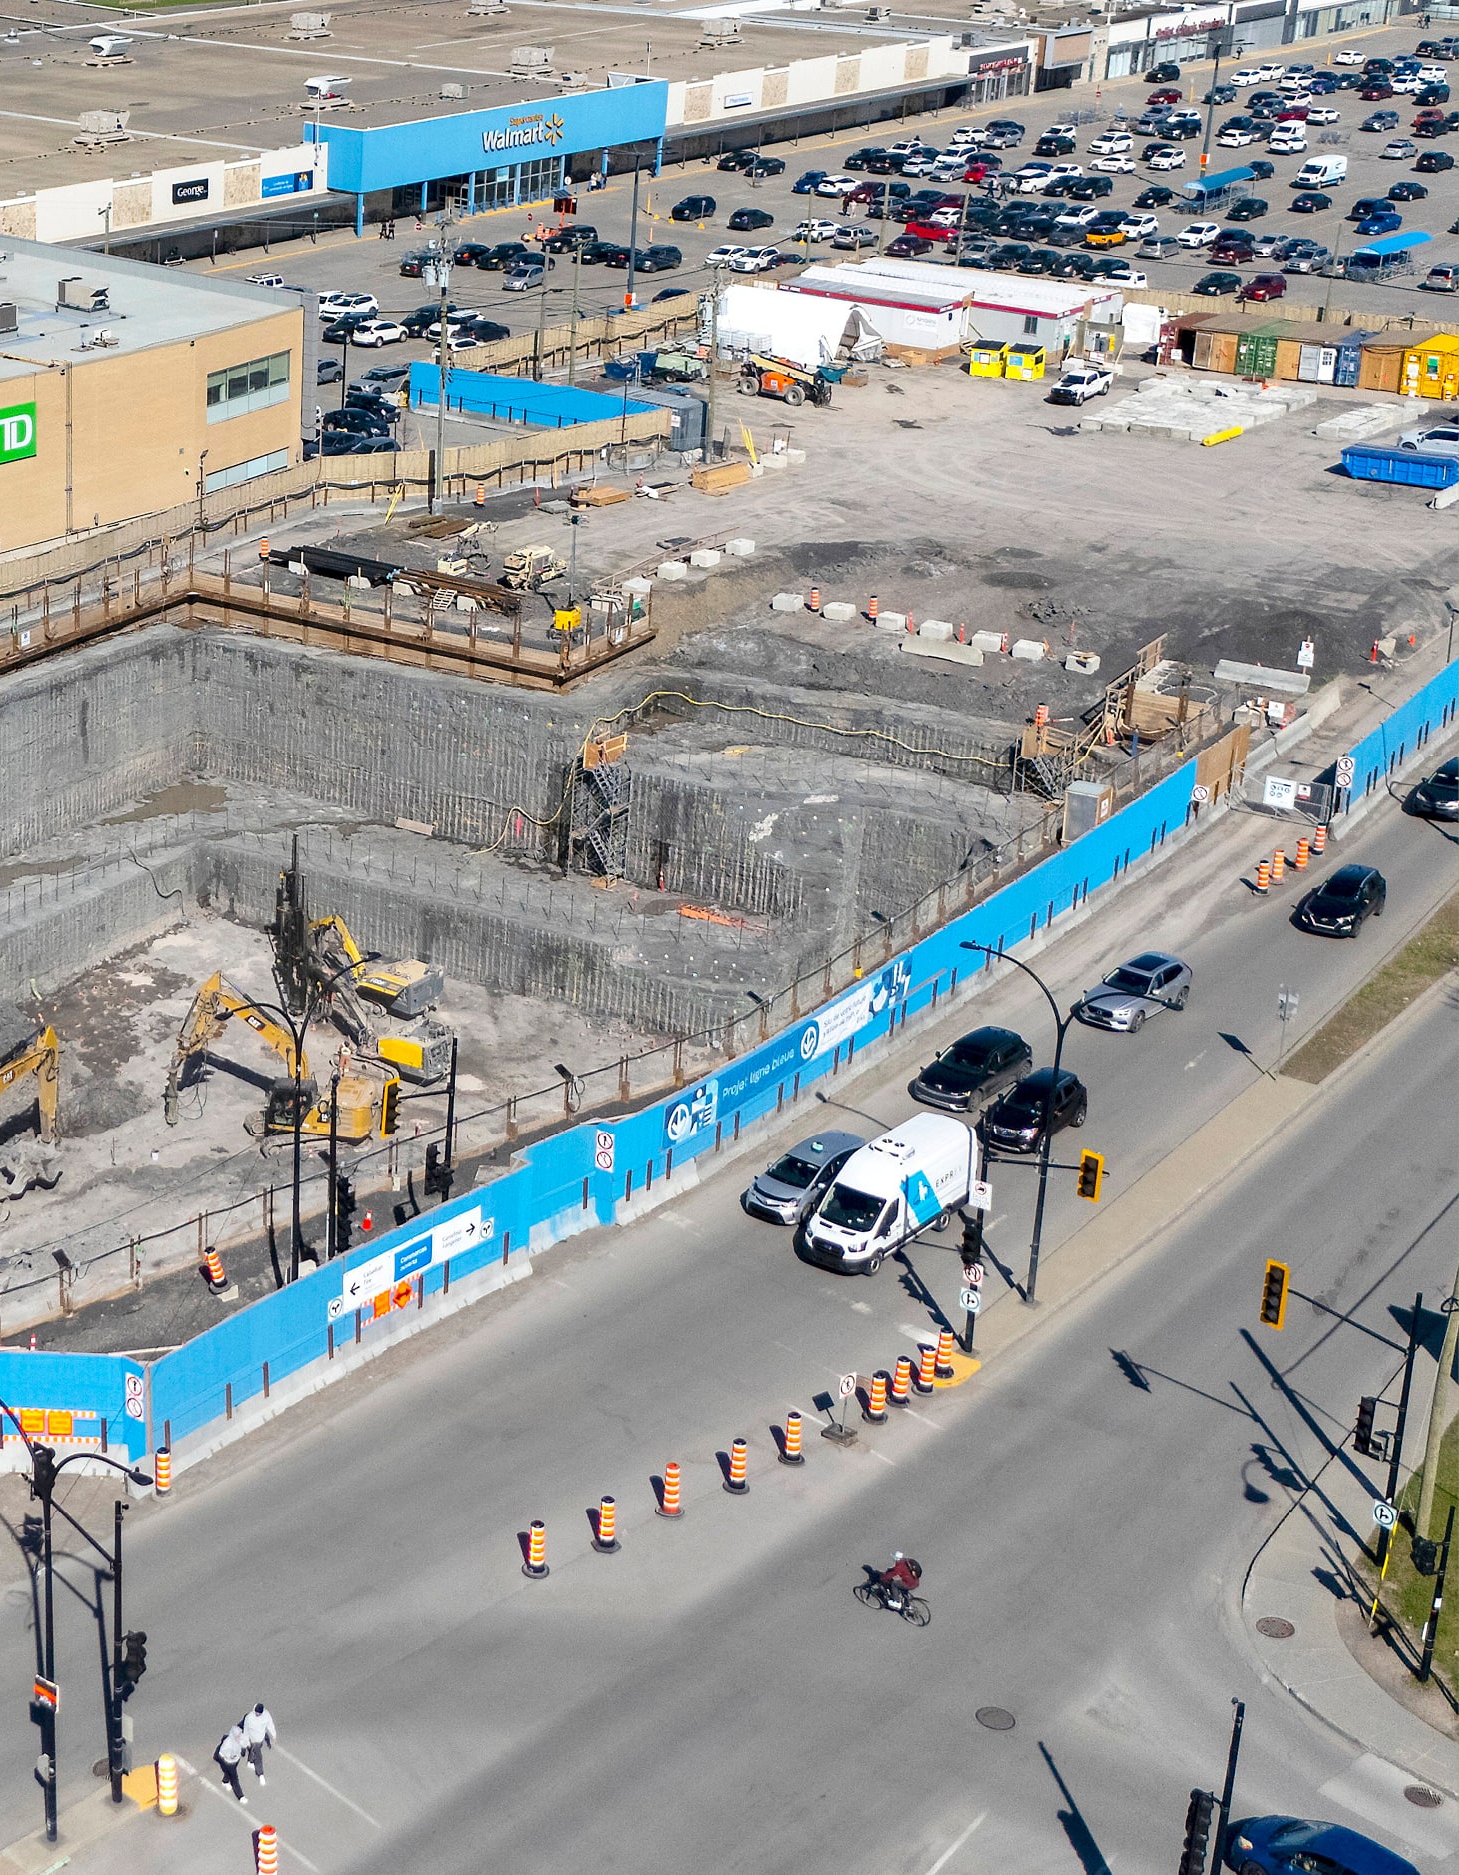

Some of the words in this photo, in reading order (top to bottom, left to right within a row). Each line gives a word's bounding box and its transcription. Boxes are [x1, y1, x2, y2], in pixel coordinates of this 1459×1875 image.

[482, 122, 543, 153] Walmart
[177, 184, 204, 197] George
[247, 1016, 261, 1029] CAT
[2, 1070, 13, 1084] CAT
[722, 1076, 748, 1100] Projet
[749, 1063, 770, 1084] ligne
[771, 1048, 795, 1070] bleue
